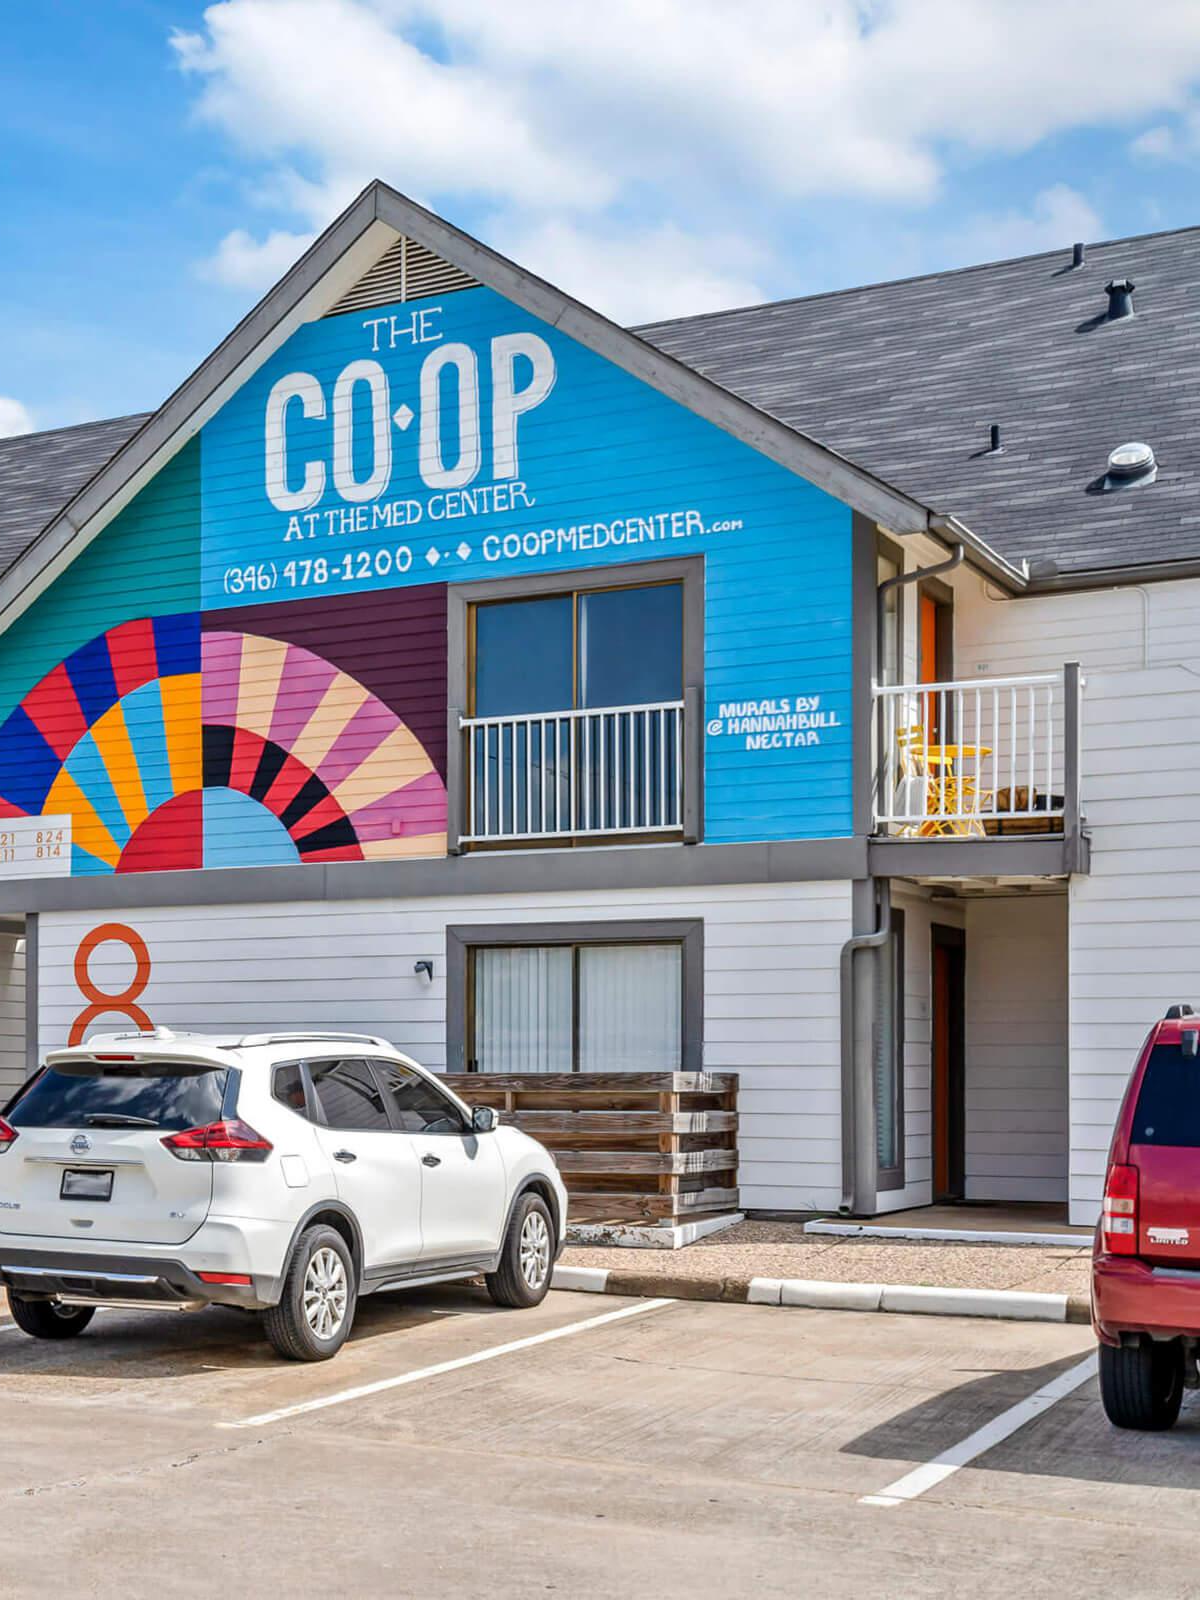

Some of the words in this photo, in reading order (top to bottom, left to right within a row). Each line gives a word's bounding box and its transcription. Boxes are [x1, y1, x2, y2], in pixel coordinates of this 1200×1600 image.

[362, 306, 443, 351] THE
[283, 514, 319, 542] AT
[324, 508, 369, 534] THE
[371, 500, 423, 529] MED
[427, 482, 535, 520] CENTER
[223, 562, 278, 593] (346)
[283, 546, 413, 588] 478-1200
[482, 509, 743, 561] COOPMEDCENTER.com
[719, 700, 790, 718] MURALS
[796, 696, 820, 711] BY
[727, 711, 841, 734] HANNAHBULL
[745, 732, 820, 750] NECTAR
[36, 831, 62, 843] 824
[36, 844, 61, 857] 814
[67, 922, 156, 1048] 8
